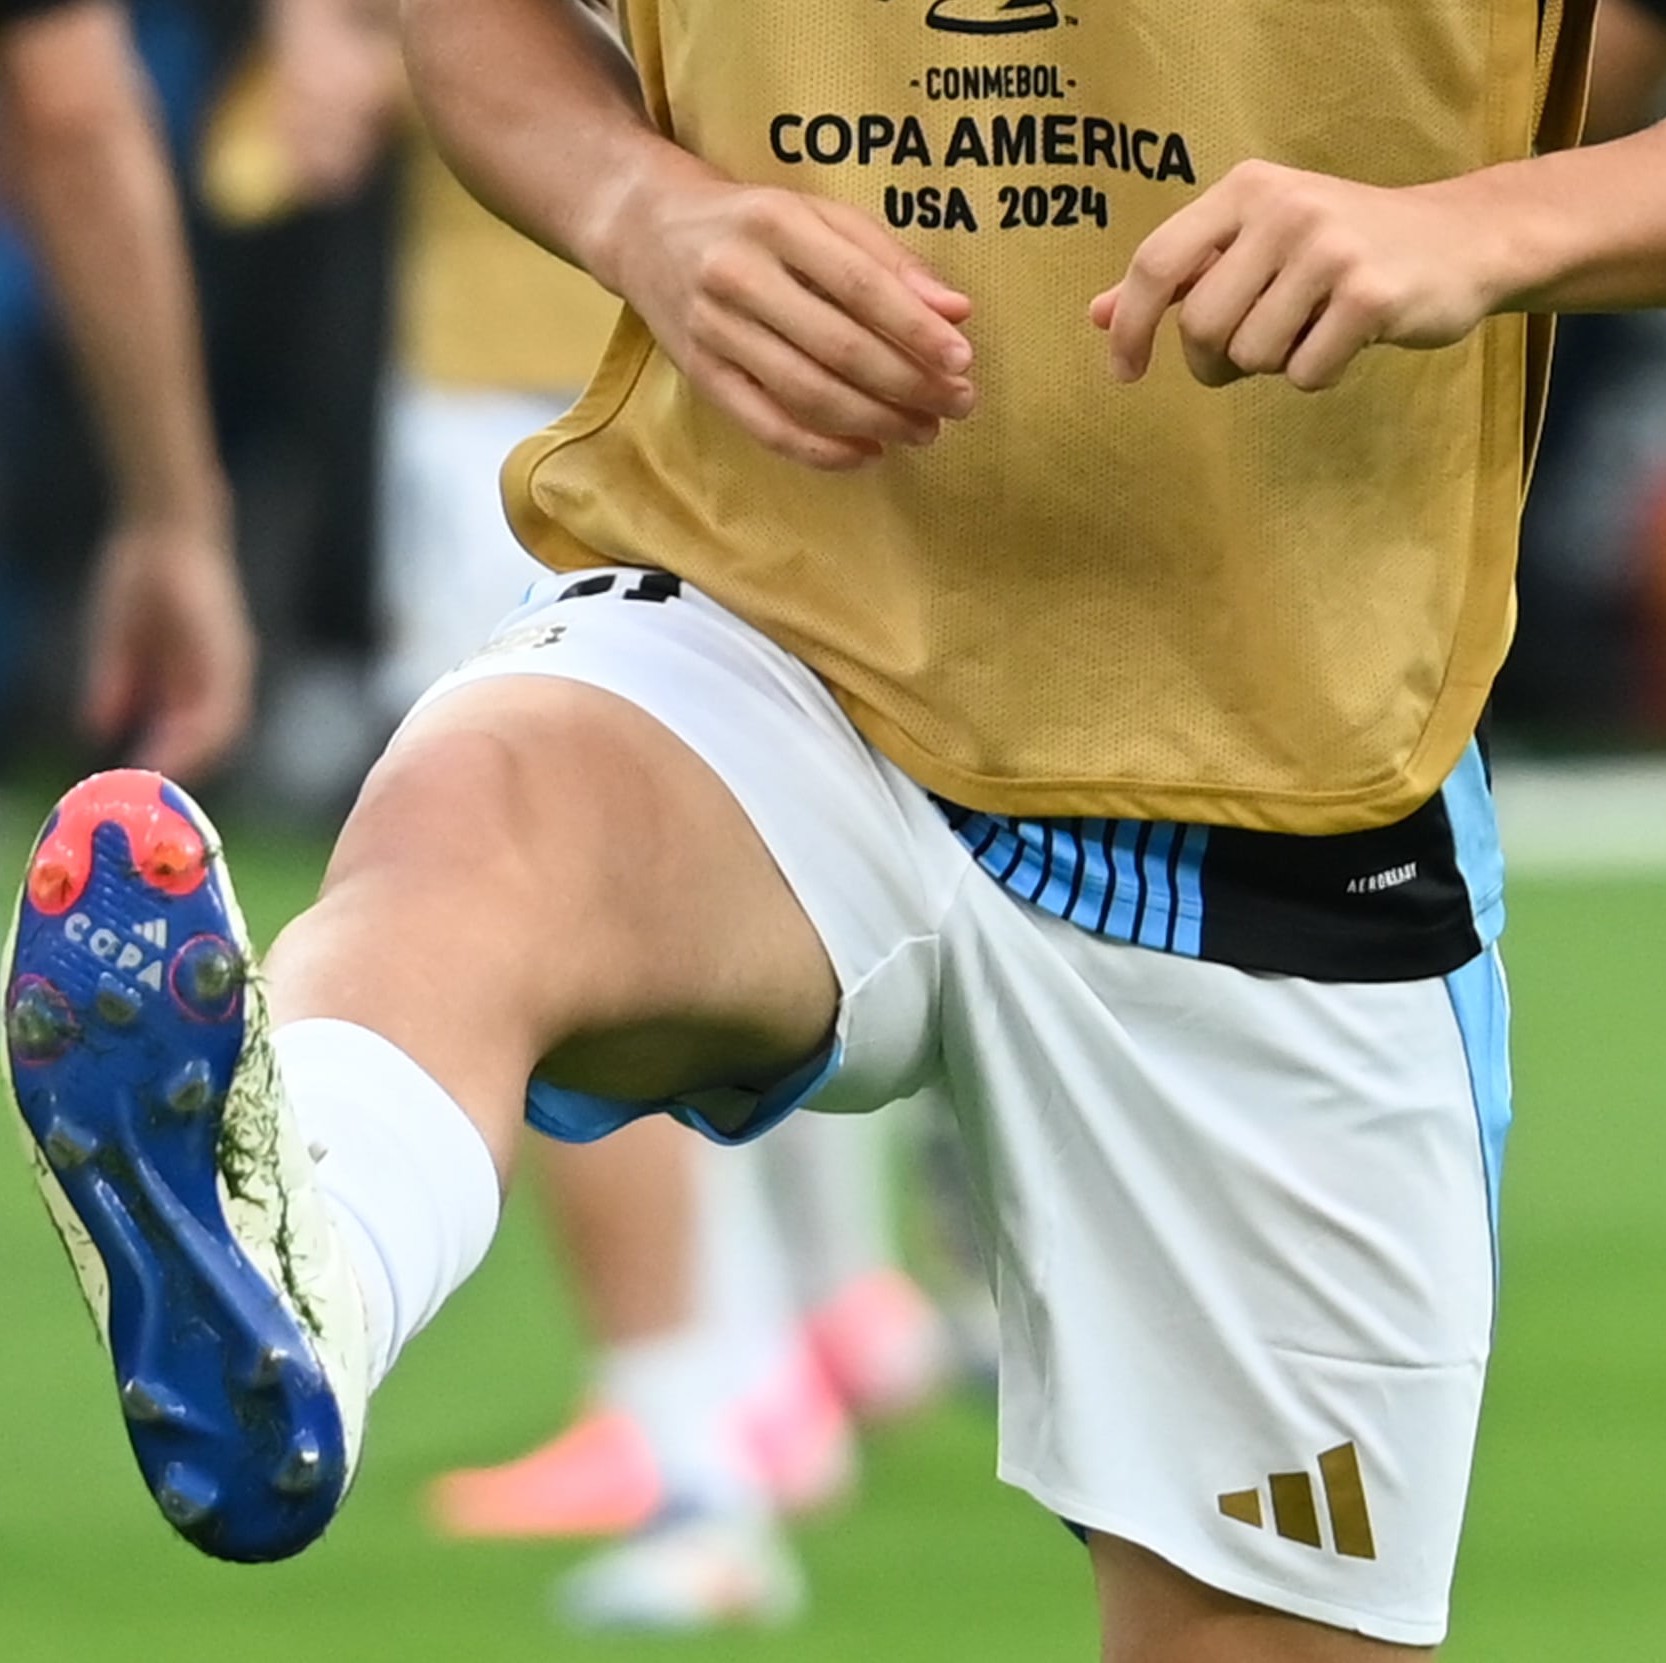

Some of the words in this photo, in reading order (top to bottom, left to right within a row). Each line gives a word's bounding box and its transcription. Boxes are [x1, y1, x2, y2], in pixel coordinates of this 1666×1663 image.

[769, 113, 932, 167] COPA
[944, 113, 1196, 185] AMERICA
[884, 185, 978, 232] USA
[998, 184, 1108, 229] 2024
[64, 912, 163, 992] COPA
